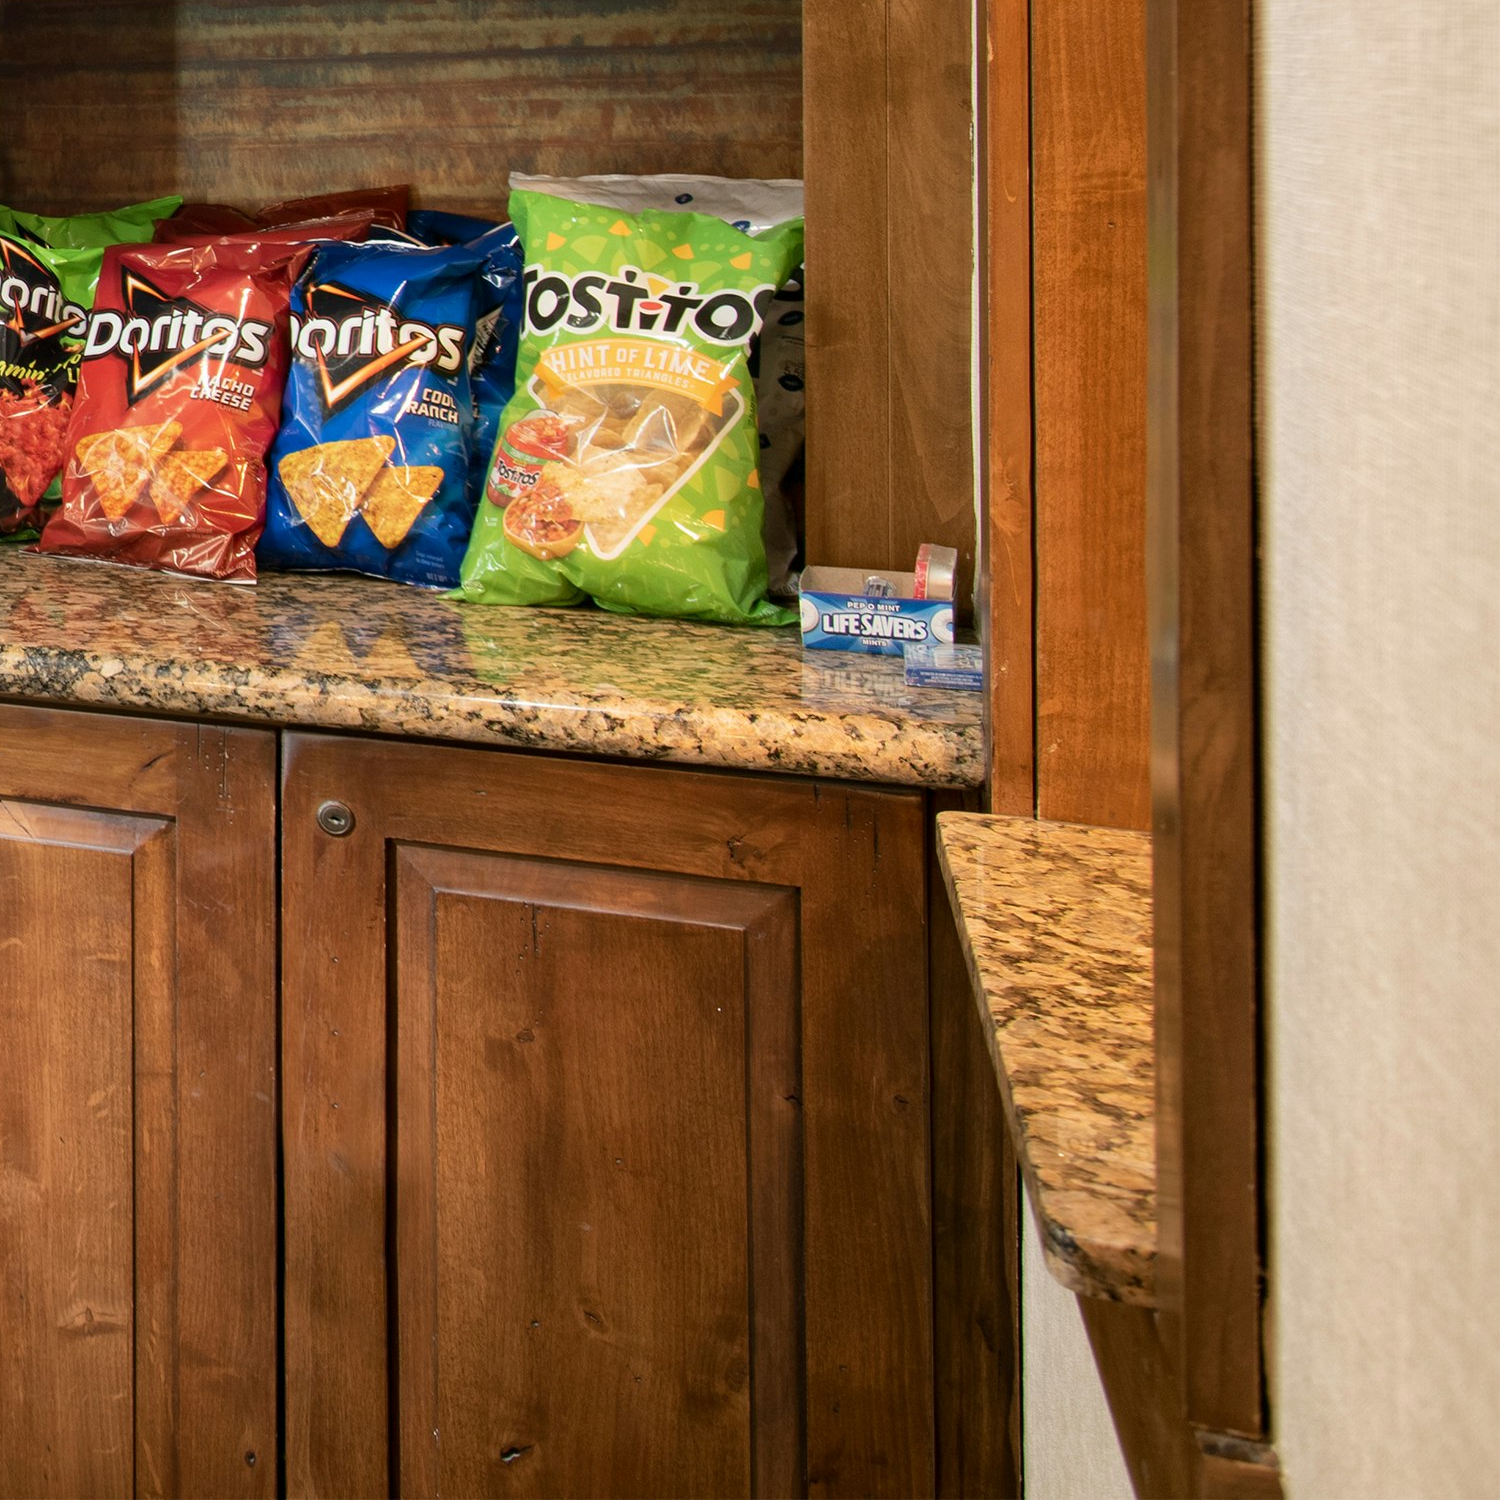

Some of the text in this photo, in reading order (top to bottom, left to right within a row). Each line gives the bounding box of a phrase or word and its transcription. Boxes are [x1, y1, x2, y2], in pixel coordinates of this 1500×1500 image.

[85, 310, 270, 362] Doritos
[552, 346, 711, 381] HINT OF LIME
[565, 367, 690, 389] FLAVORED TRIANGLES
[190, 388, 252, 412] CHEESE
[422, 387, 457, 409] COOL
[408, 401, 459, 424] RANCH
[498, 463, 539, 486] TOSTITOS
[847, 601, 865, 610] PEP
[877, 603, 901, 612] MINT
[823, 613, 928, 640] LIFE SAVERS
[862, 638, 888, 647] MINTS
